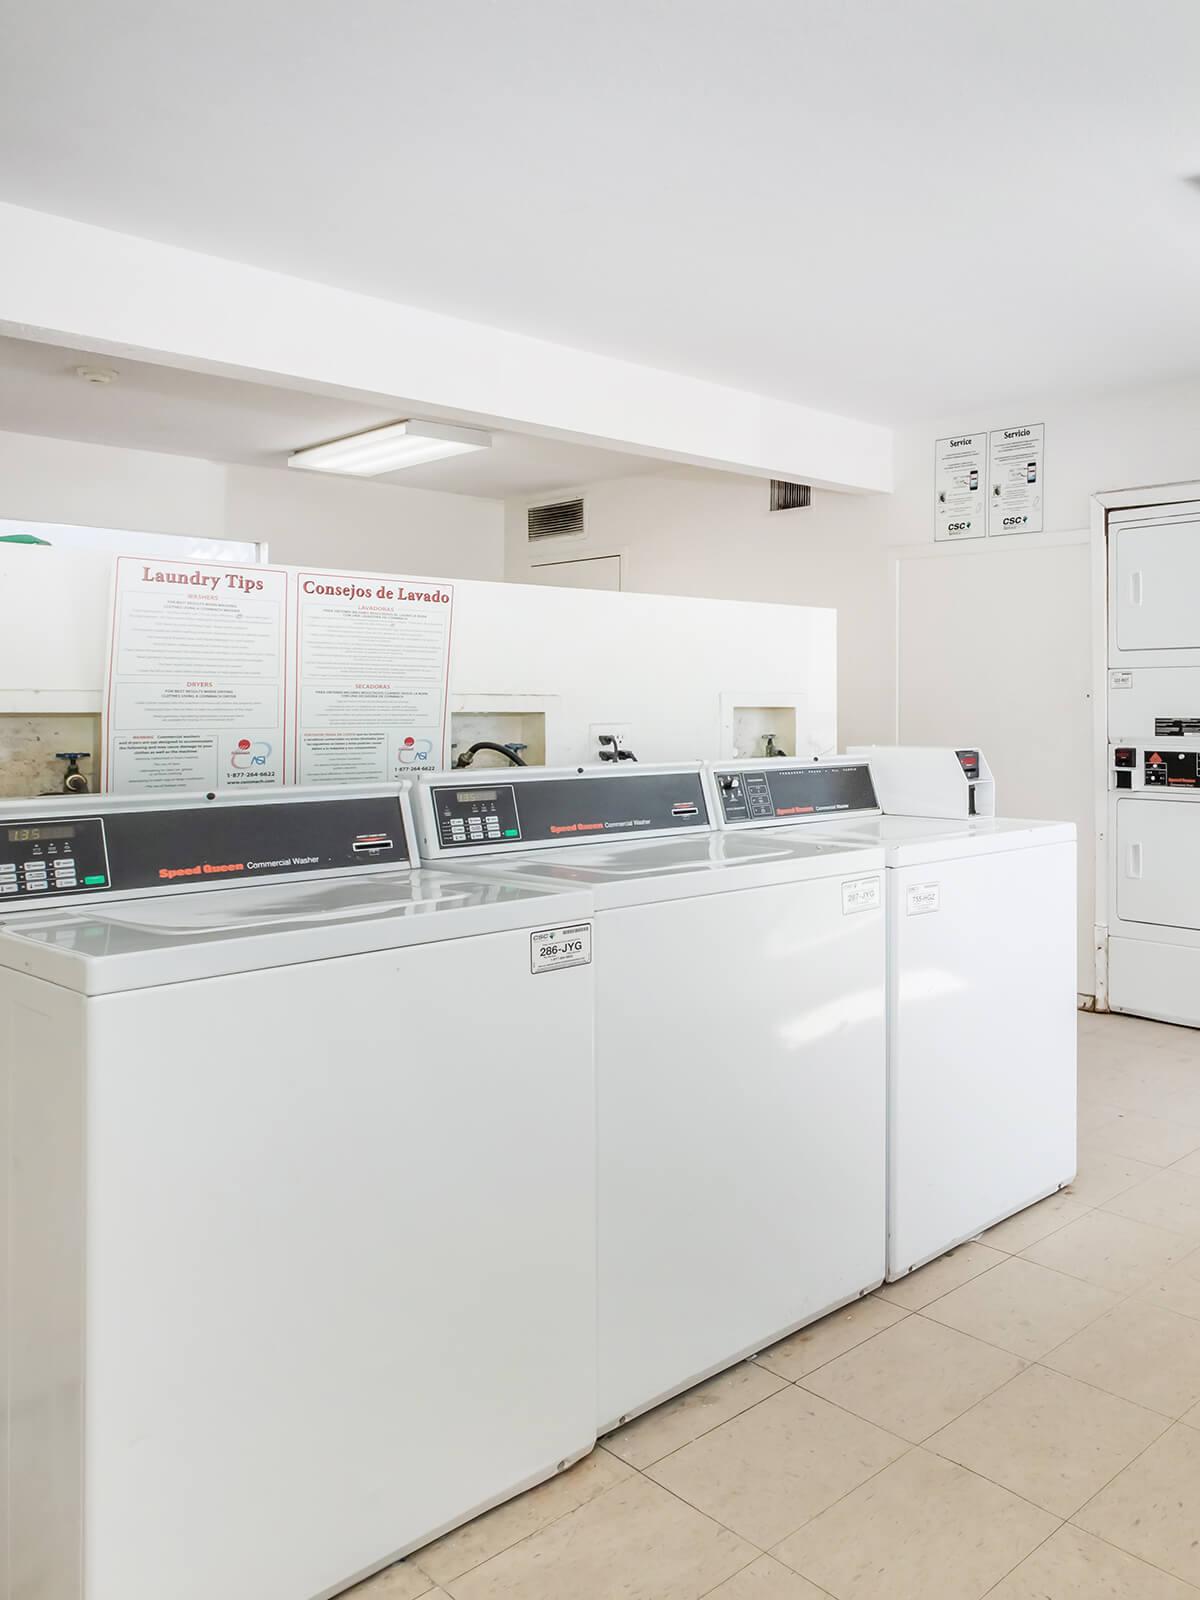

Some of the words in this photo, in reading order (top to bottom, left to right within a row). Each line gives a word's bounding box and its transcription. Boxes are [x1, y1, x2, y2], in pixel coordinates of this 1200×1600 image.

[1004, 429, 1030, 439] Servicio
[949, 438, 972, 448] Service
[948, 522, 966, 531] CSC
[1003, 516, 1022, 525] CSC
[142, 566, 220, 591] Laundry
[225, 574, 264, 593] Tips
[303, 580, 372, 600] Consejos
[376, 586, 394, 600] de
[398, 587, 450, 604] Lavado
[159, 866, 201, 879] Speed
[203, 862, 243, 874] Queen
[246, 858, 291, 870] Commercial
[292, 856, 319, 865] Washer
[539, 940, 583, 957] 286-JYG
